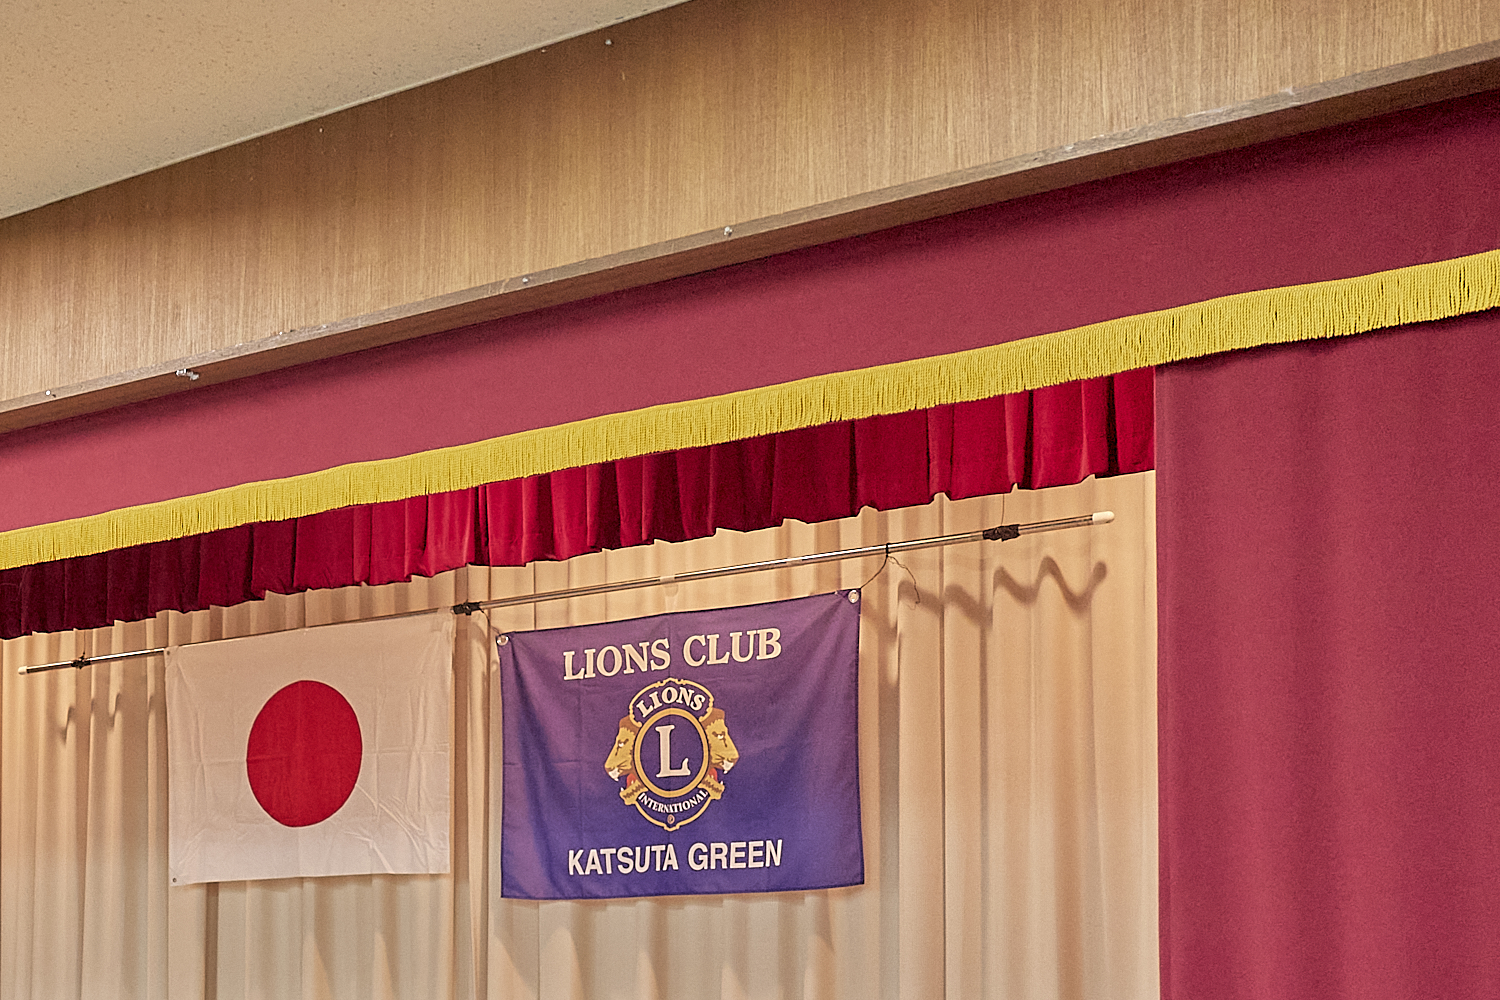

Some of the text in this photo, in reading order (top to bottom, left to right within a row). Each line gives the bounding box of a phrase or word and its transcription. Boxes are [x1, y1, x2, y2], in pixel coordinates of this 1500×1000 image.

[563, 627, 782, 680] LIONS CLUB
[636, 686, 706, 718] LIONS
[654, 724, 691, 778] L
[637, 789, 709, 814] INTERNATIONAL
[568, 839, 783, 875] KATSUTA GREEN
